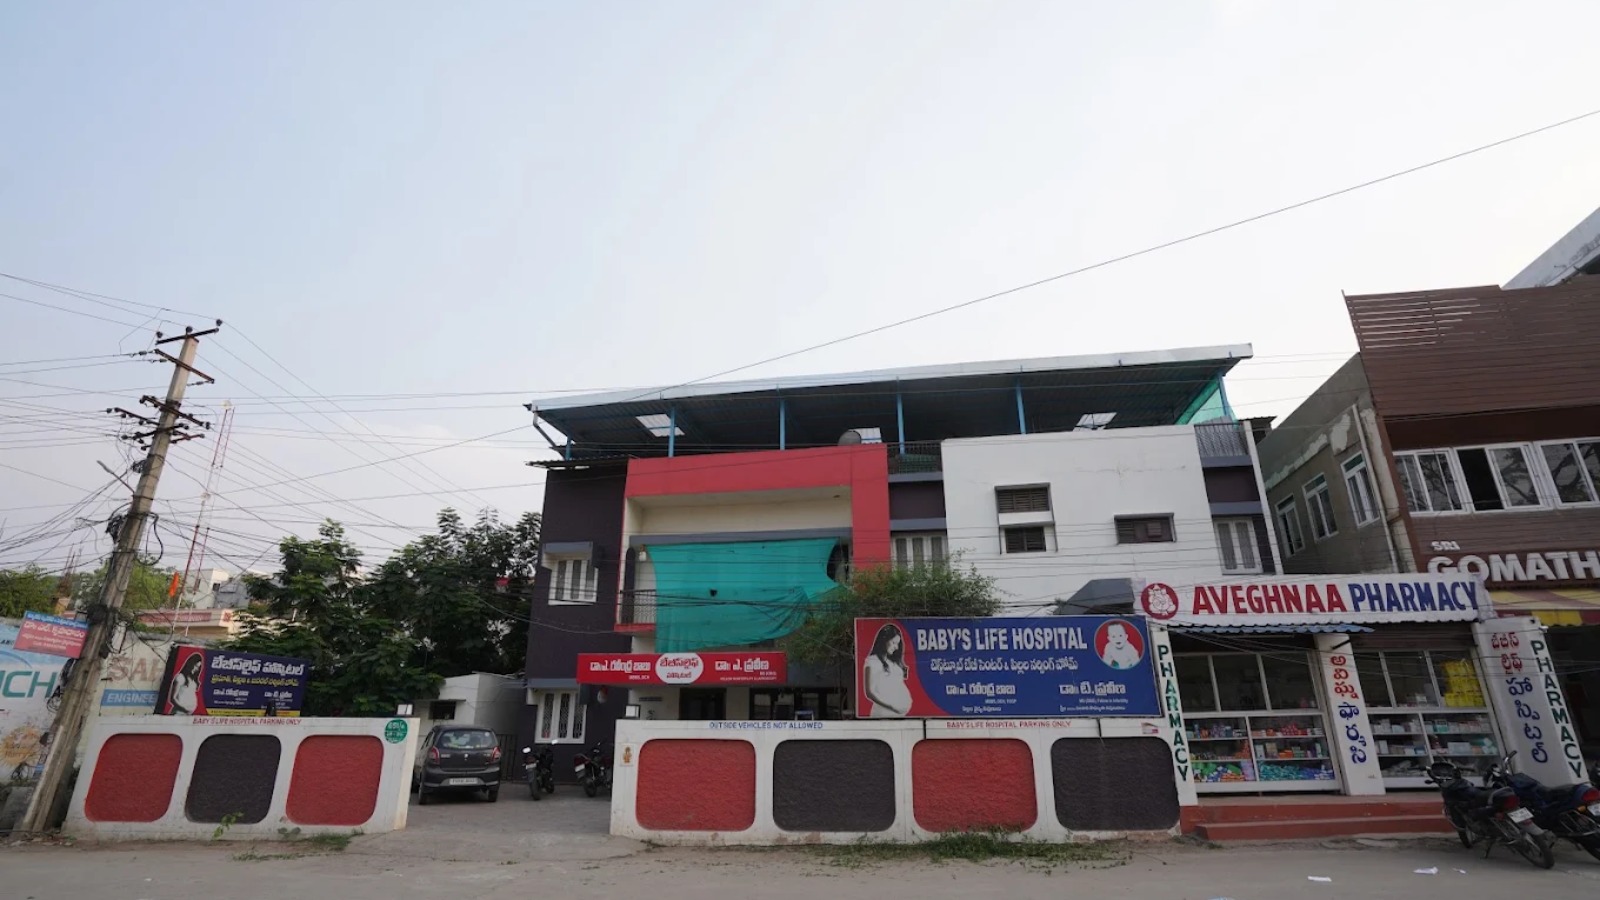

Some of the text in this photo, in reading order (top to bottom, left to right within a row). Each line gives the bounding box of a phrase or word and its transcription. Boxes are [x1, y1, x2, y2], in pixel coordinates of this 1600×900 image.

[1430, 540, 1461, 551] SRI
[1427, 551, 1600, 582] GOMATH
[1192, 581, 1479, 615] AVEGHNAA PHARMACY
[917, 626, 1088, 651] BABY'S LIFE HOSPITAL
[107, 692, 157, 704] ENGINEE
[1530, 640, 1582, 779] PHARMACY
[738, 721, 771, 729] VEHICLES
[773, 721, 788, 729] NOT
[789, 721, 823, 729] ALLOWED
[985, 720, 1016, 728] HOSPITAL
[1019, 720, 1050, 728] PARKING
[1157, 644, 1189, 782] PHARMACY
